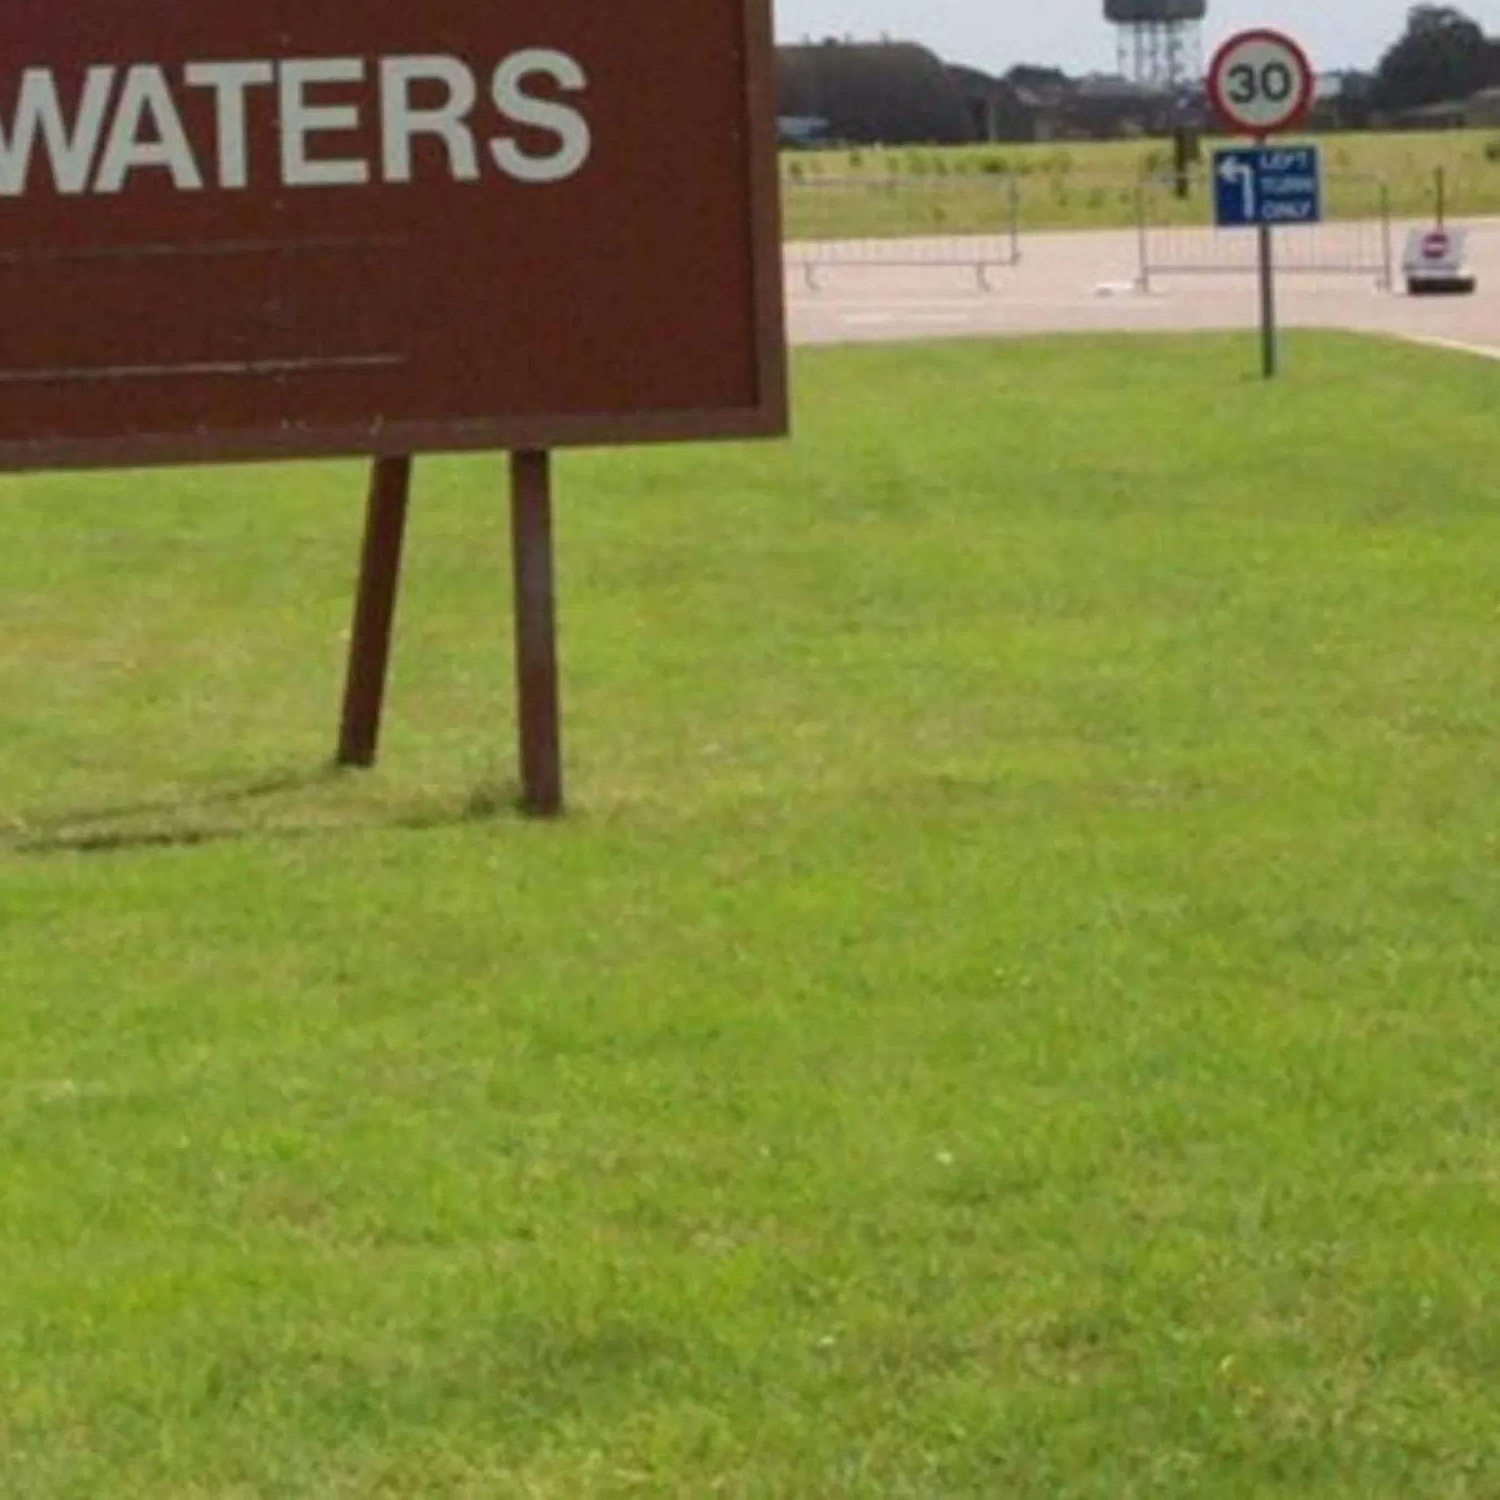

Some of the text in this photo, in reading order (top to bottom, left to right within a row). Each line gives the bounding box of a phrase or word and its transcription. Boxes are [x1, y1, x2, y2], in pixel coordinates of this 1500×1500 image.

[1228, 62, 1293, 104] 30
[1259, 152, 1307, 170] LEFT
[1260, 199, 1311, 218] ONLY
